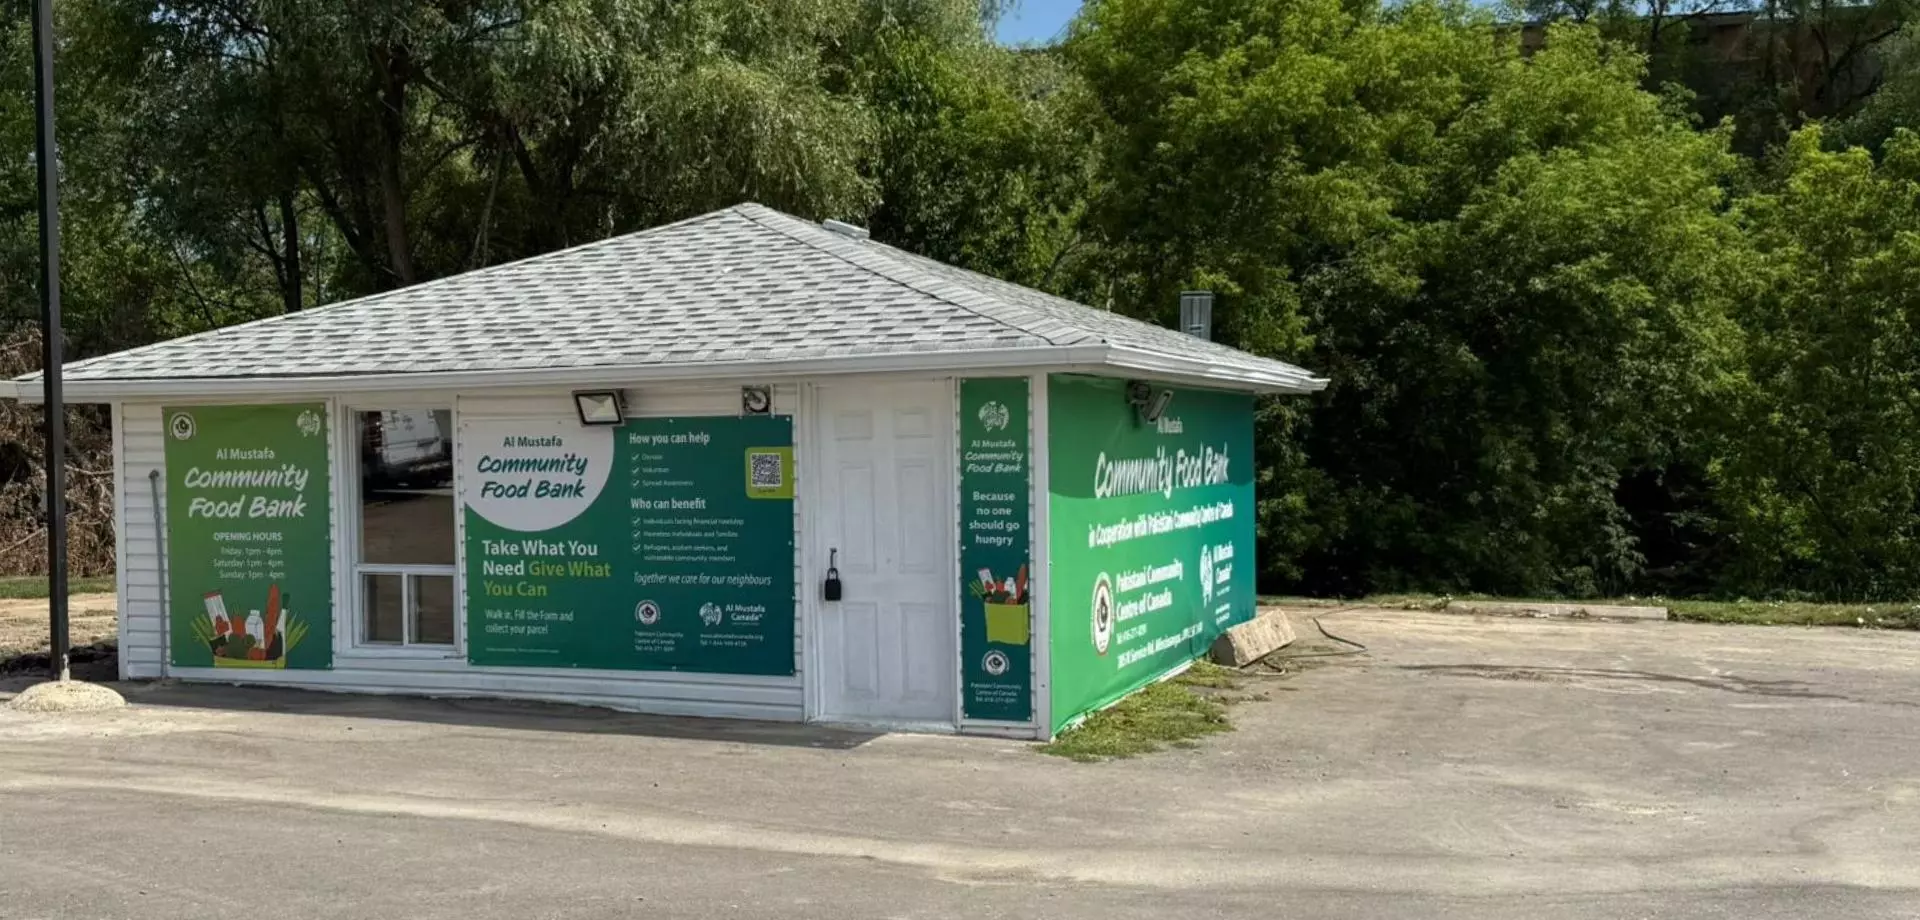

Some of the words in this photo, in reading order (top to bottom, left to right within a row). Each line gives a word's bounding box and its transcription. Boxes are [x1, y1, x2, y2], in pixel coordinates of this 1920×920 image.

[1157, 417, 1164, 434] Al
[1164, 416, 1183, 434] Mustafa
[503, 436, 515, 448] Al
[517, 435, 563, 448] Mustafa
[629, 432, 650, 445] How
[652, 434, 668, 446] you
[670, 435, 688, 444] can
[689, 432, 710, 446] help
[971, 440, 980, 448] Al
[982, 439, 1016, 448] Mustafa
[216, 448, 228, 460] Al
[230, 447, 276, 460] Mustafa
[965, 450, 1023, 462] Community
[478, 453, 588, 476] Community
[966, 462, 994, 473] Food
[994, 462, 1022, 473] Bank
[1094, 445, 1173, 499] Community
[1175, 440, 1203, 488] Food
[1204, 441, 1230, 485] Bank
[184, 463, 309, 491] Community
[481, 478, 532, 499] Food
[535, 478, 586, 499] Bank
[973, 491, 1016, 502] Because
[188, 494, 246, 518] Food
[248, 494, 307, 518] Bank
[630, 498, 652, 510] Who
[653, 499, 670, 509] can
[671, 497, 706, 510] benefit
[976, 508, 990, 516] no
[992, 508, 1012, 516] one
[969, 520, 1004, 530] should
[1005, 522, 1020, 532] go
[1089, 523, 1095, 548] in
[1095, 517, 1133, 548] Cooperation
[1134, 513, 1147, 537] with
[1147, 509, 1173, 536] Pakistani
[1174, 505, 1201, 528] Community
[213, 531, 251, 541] OPENING
[253, 531, 283, 541] HOURS
[703, 530, 715, 538] and
[975, 534, 1013, 546] hungry
[481, 540, 519, 556] Take
[521, 540, 565, 556] What
[568, 540, 598, 556] You
[483, 560, 525, 576] Need
[529, 561, 565, 577] Give
[567, 561, 611, 577] What
[633, 572, 667, 586] Together
[668, 575, 679, 584] we
[681, 575, 698, 585] care
[698, 572, 709, 585] for
[711, 576, 726, 585] our
[726, 573, 772, 588] neighbours
[1116, 566, 1146, 593] Pakistani
[1147, 559, 1183, 584] Community
[484, 581, 513, 597] You
[516, 581, 548, 597] Can
[726, 604, 734, 613] Al
[734, 604, 766, 613] Mustafa
[1117, 601, 1138, 622] Centre
[1138, 592, 1147, 614] of
[1147, 586, 1172, 611] Canada
[485, 609, 503, 620] Walk
[514, 609, 525, 620] Fill
[526, 609, 539, 621] the
[539, 609, 558, 621] Form
[559, 610, 574, 621] and
[485, 623, 509, 634] collect
[510, 625, 526, 636] your
